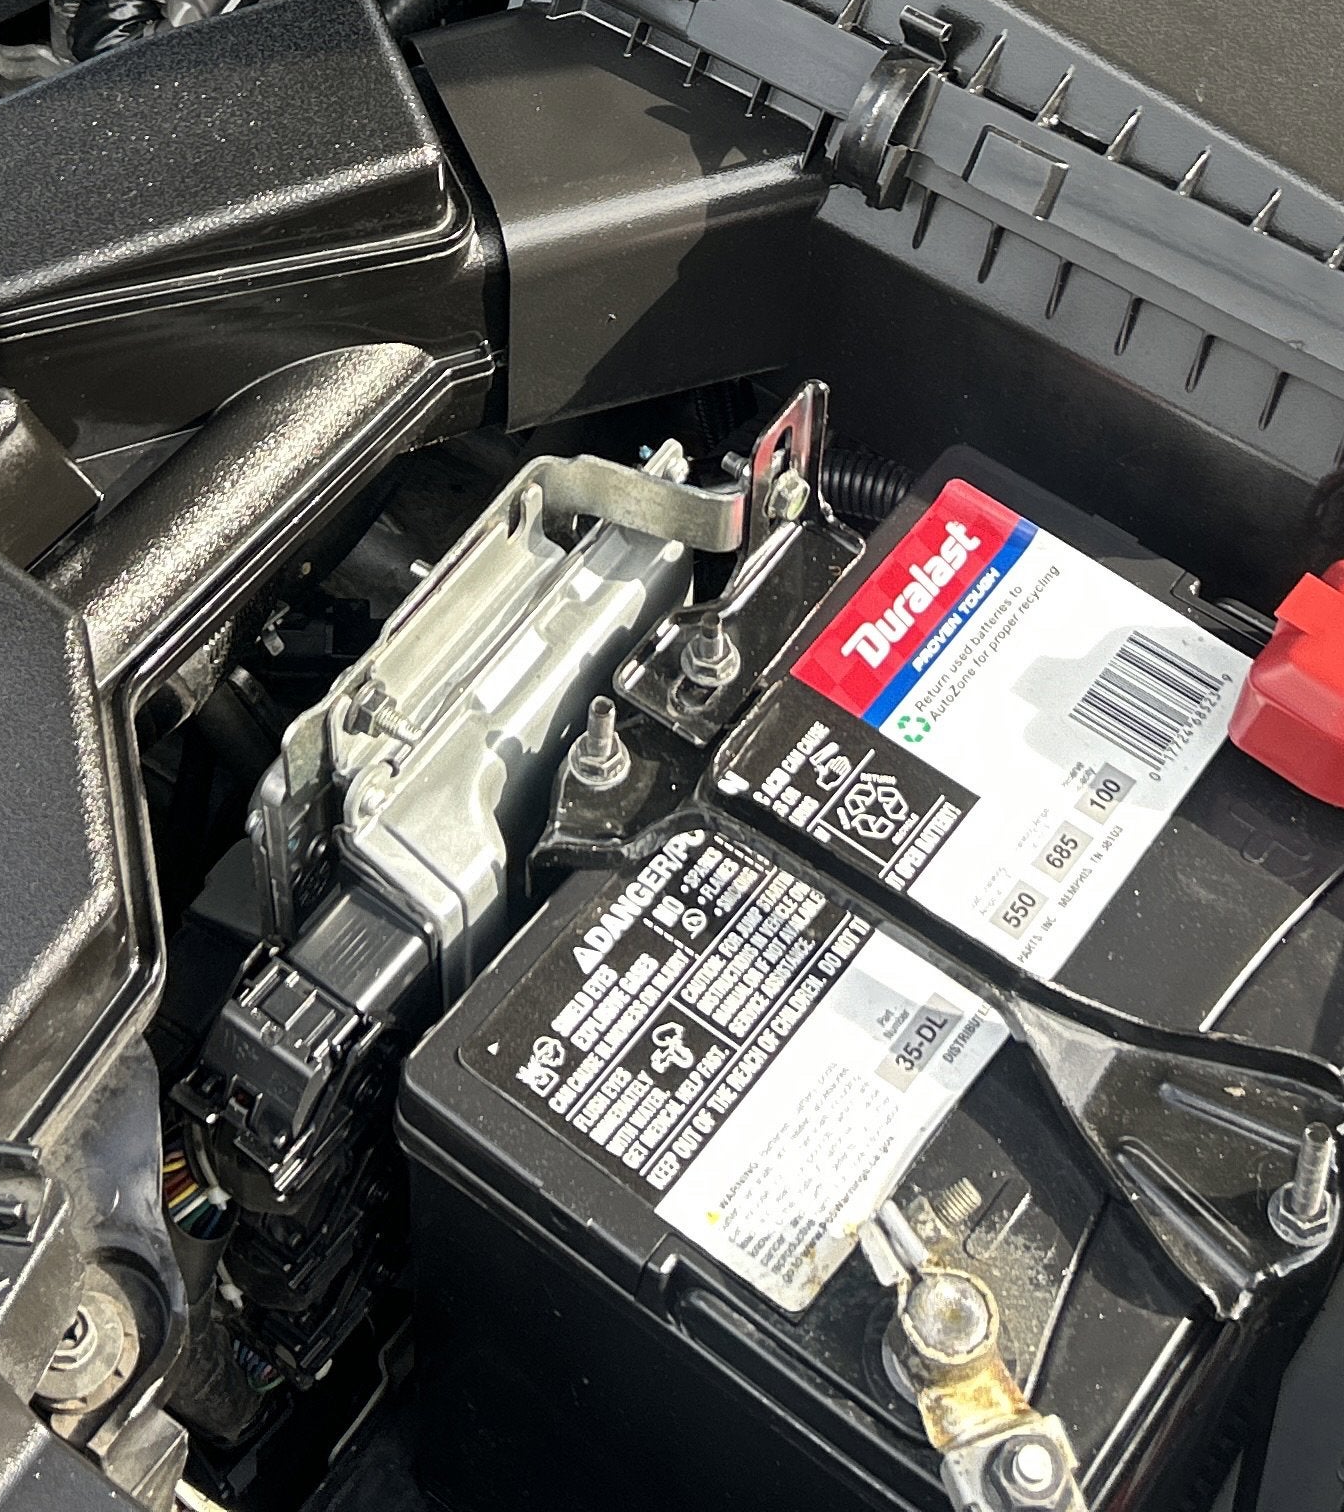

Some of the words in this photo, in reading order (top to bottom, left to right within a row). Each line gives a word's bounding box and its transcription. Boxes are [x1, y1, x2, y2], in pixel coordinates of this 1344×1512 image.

[838, 515, 985, 676] Duralast
[909, 611, 965, 673] PROVEN
[955, 565, 1002, 616] TOUGH
[913, 671, 952, 713] Return
[945, 643, 974, 674] used
[966, 595, 1013, 646] batteries
[1005, 582, 1023, 597] to
[928, 666, 977, 722] AutoZone
[971, 648, 991, 668] for
[986, 612, 1023, 652] proper
[1015, 563, 1062, 616] recycling
[779, 747, 808, 775] CAN
[1162, 726, 1194, 762] 17724
[1086, 775, 1123, 813] 100
[1043, 832, 1081, 871] 685
[581, 828, 708, 955] DANGER/PO
[649, 893, 688, 928] NO
[1000, 889, 1038, 929] 550
[716, 930, 746, 958] FOR
[732, 904, 767, 939] JUMP
[757, 894, 800, 939] VEHICLE
[747, 931, 770, 950] IN
[760, 936, 790, 964] NOT
[828, 927, 863, 959] NOT
[693, 942, 761, 1016] INSTRUCTIONS
[740, 966, 766, 989] OR
[752, 956, 774, 974] IF
[815, 950, 844, 976] DO
[548, 989, 597, 1038] SHIELD
[580, 962, 620, 1001] EYES
[568, 985, 632, 1052] EXPLOSIVE
[615, 951, 661, 996] GASES
[710, 979, 755, 1027] MANUAL
[725, 990, 772, 1039] SERVICE
[874, 1007, 895, 1028] Part
[754, 1026, 783, 1054] OF
[882, 1007, 911, 1040] Number
[892, 1009, 949, 1073] 35-DL
[546, 1083, 579, 1115] CAN
[564, 1050, 606, 1094] CAUSE
[591, 997, 651, 1061] BLINDNESS
[636, 983, 663, 1007] OR
[723, 1044, 770, 1093] REACH
[571, 1090, 612, 1134] FLUSH
[599, 1065, 633, 1100] EYES
[587, 1068, 657, 1146] IMMEDIATELY
[620, 1139, 652, 1171] GET
[673, 1069, 708, 1105] HELP
[694, 1041, 731, 1079] FAST.
[705, 1082, 739, 1116] THE
[604, 1121, 640, 1158] WITH
[690, 1107, 720, 1135] OF
[670, 1124, 706, 1160] OUT
[645, 1150, 686, 1192] KEEP
